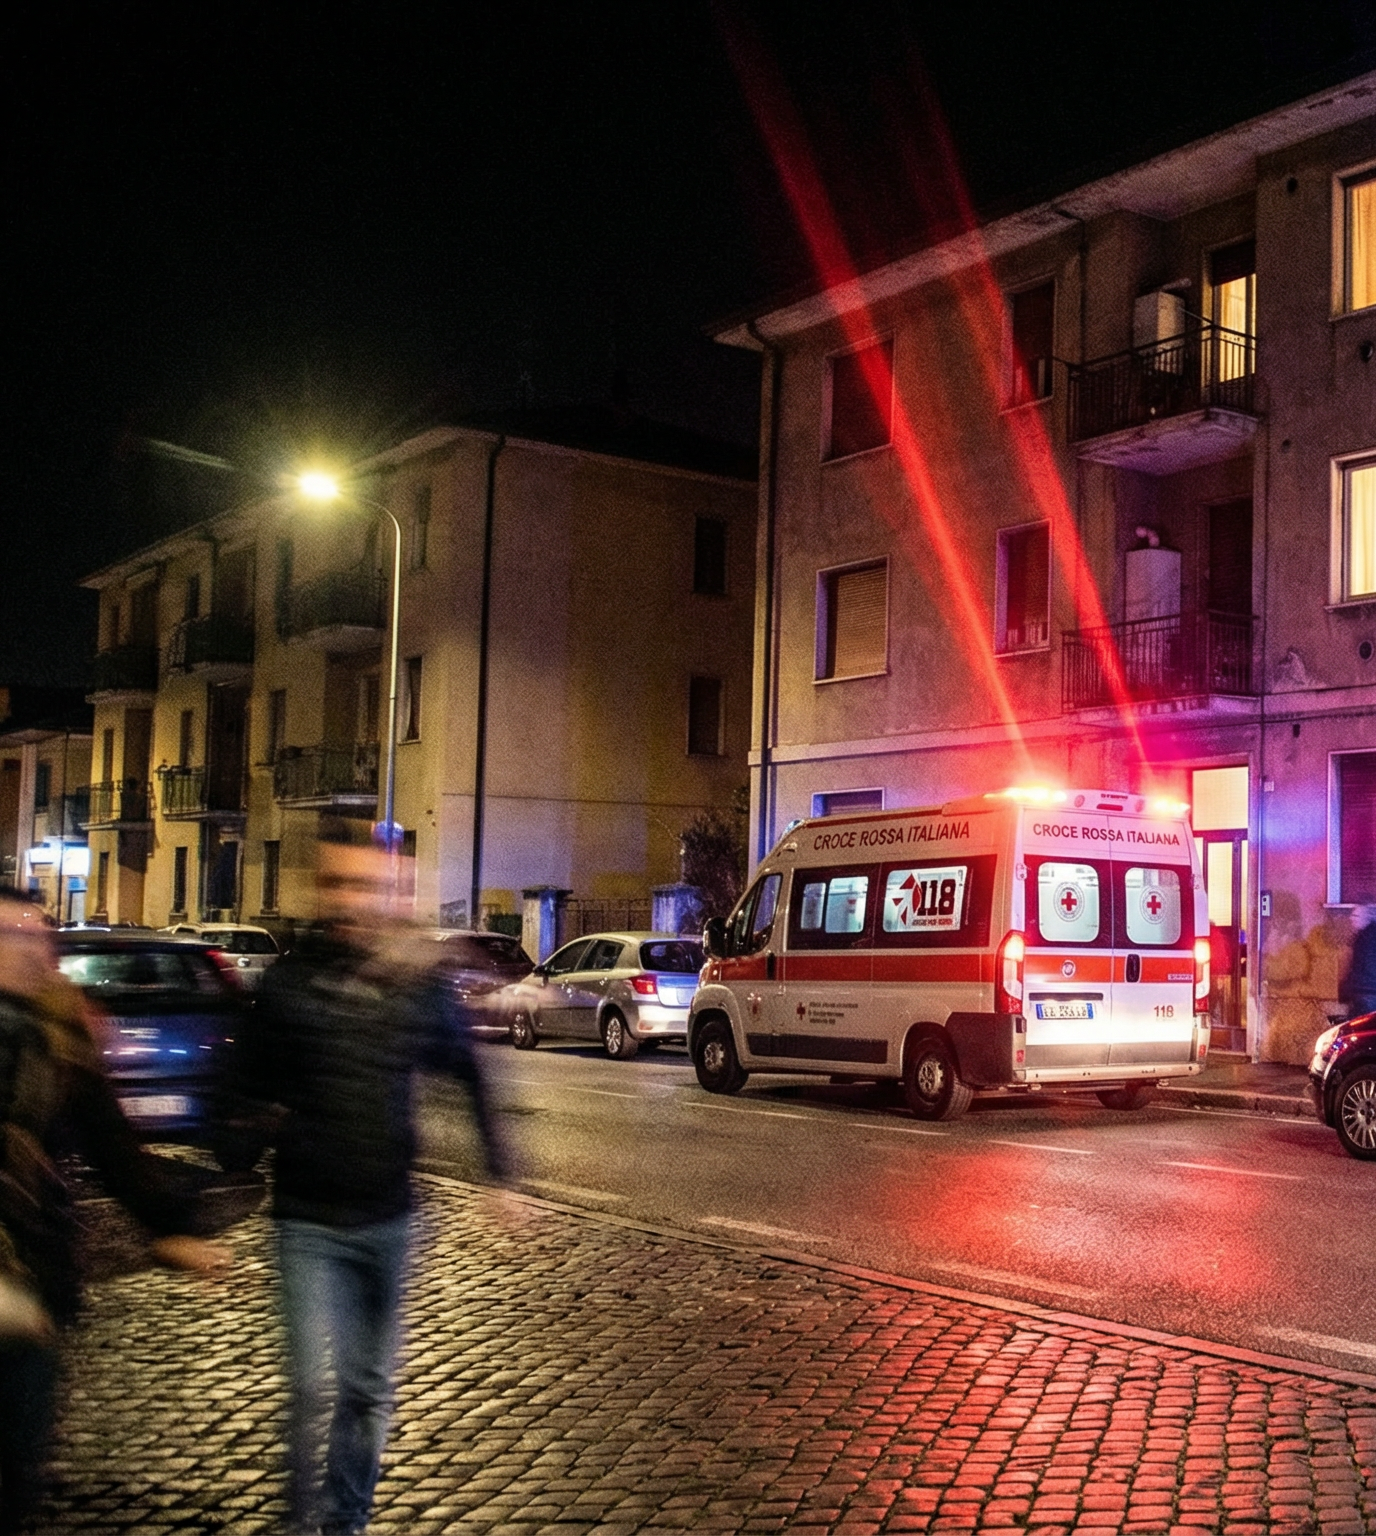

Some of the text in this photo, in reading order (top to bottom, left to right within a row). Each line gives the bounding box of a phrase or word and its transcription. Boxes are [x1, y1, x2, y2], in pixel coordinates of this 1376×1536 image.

[813, 821, 970, 850] CROCE ROSSA ITALIANA
[1033, 823, 1180, 846] CROCE ROSSA ITALIANA
[917, 878, 956, 916] 118
[1153, 1004, 1174, 1018] 118
